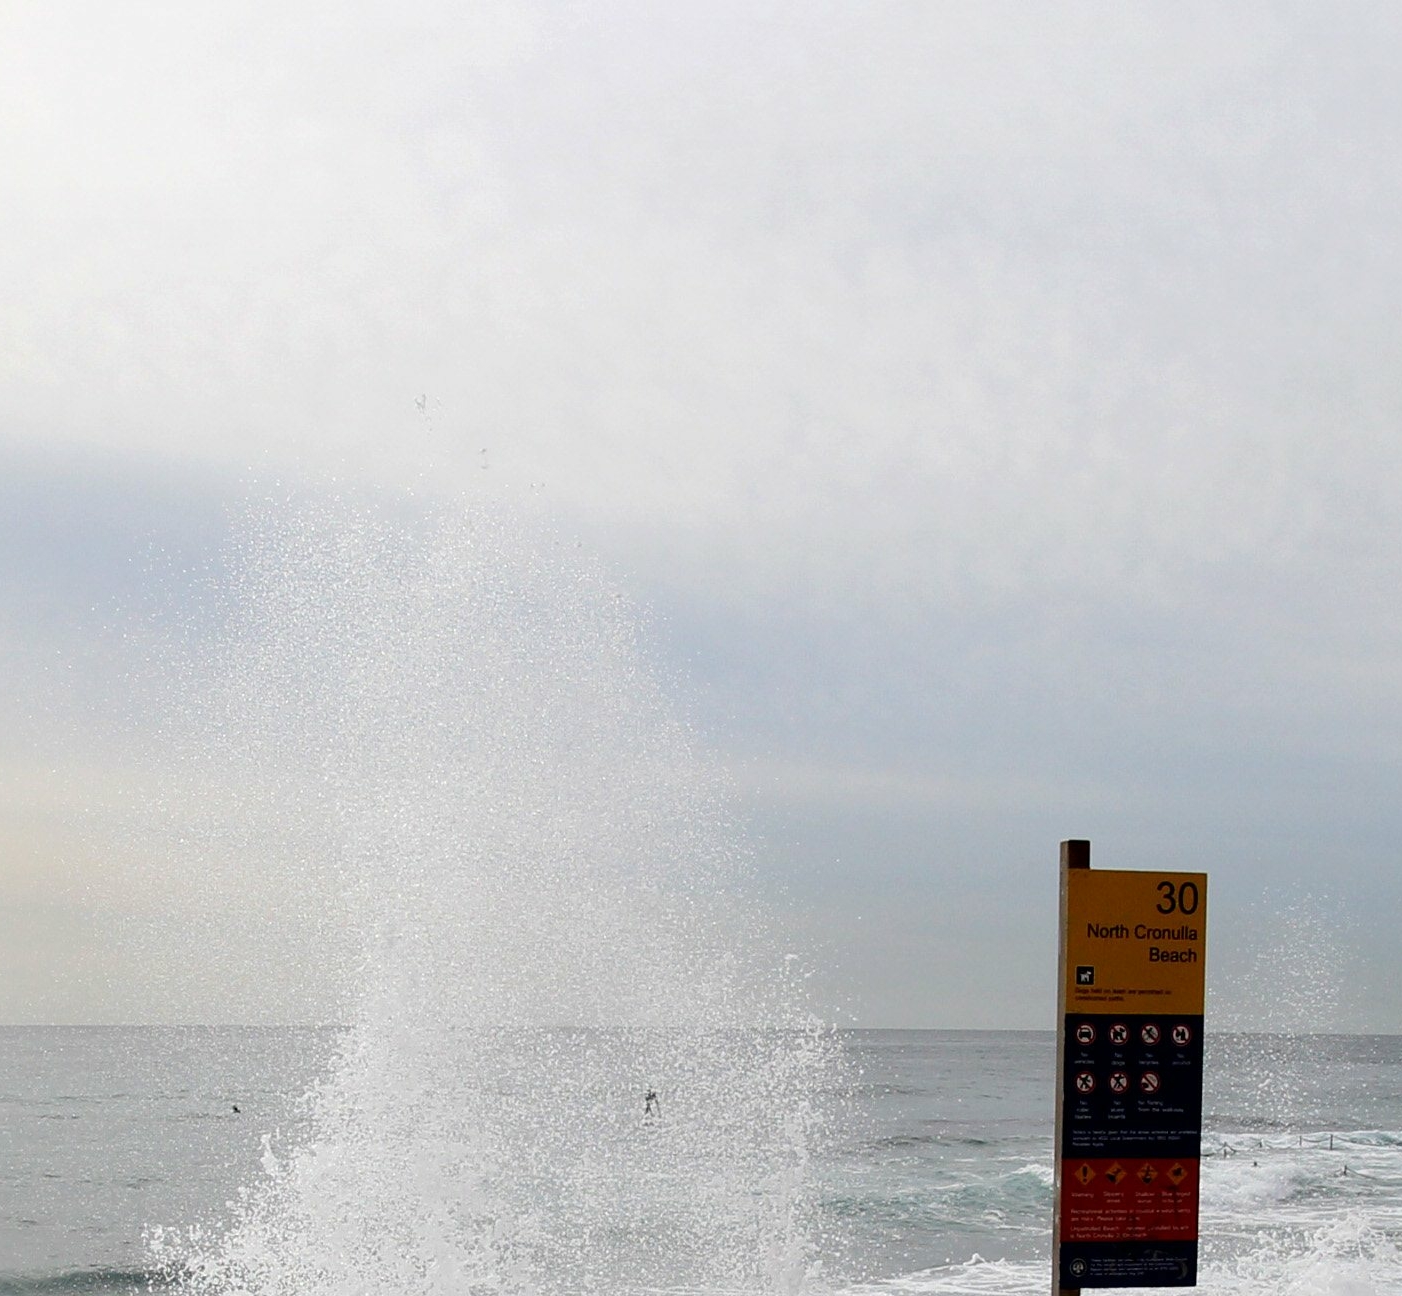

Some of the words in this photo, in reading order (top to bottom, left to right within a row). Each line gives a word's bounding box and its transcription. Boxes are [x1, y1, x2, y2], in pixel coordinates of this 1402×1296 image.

[1156, 881, 1198, 915] 30
[1087, 923, 1129, 939] North
[1134, 924, 1198, 941] Cronulla
[1149, 947, 1197, 962] Beach
